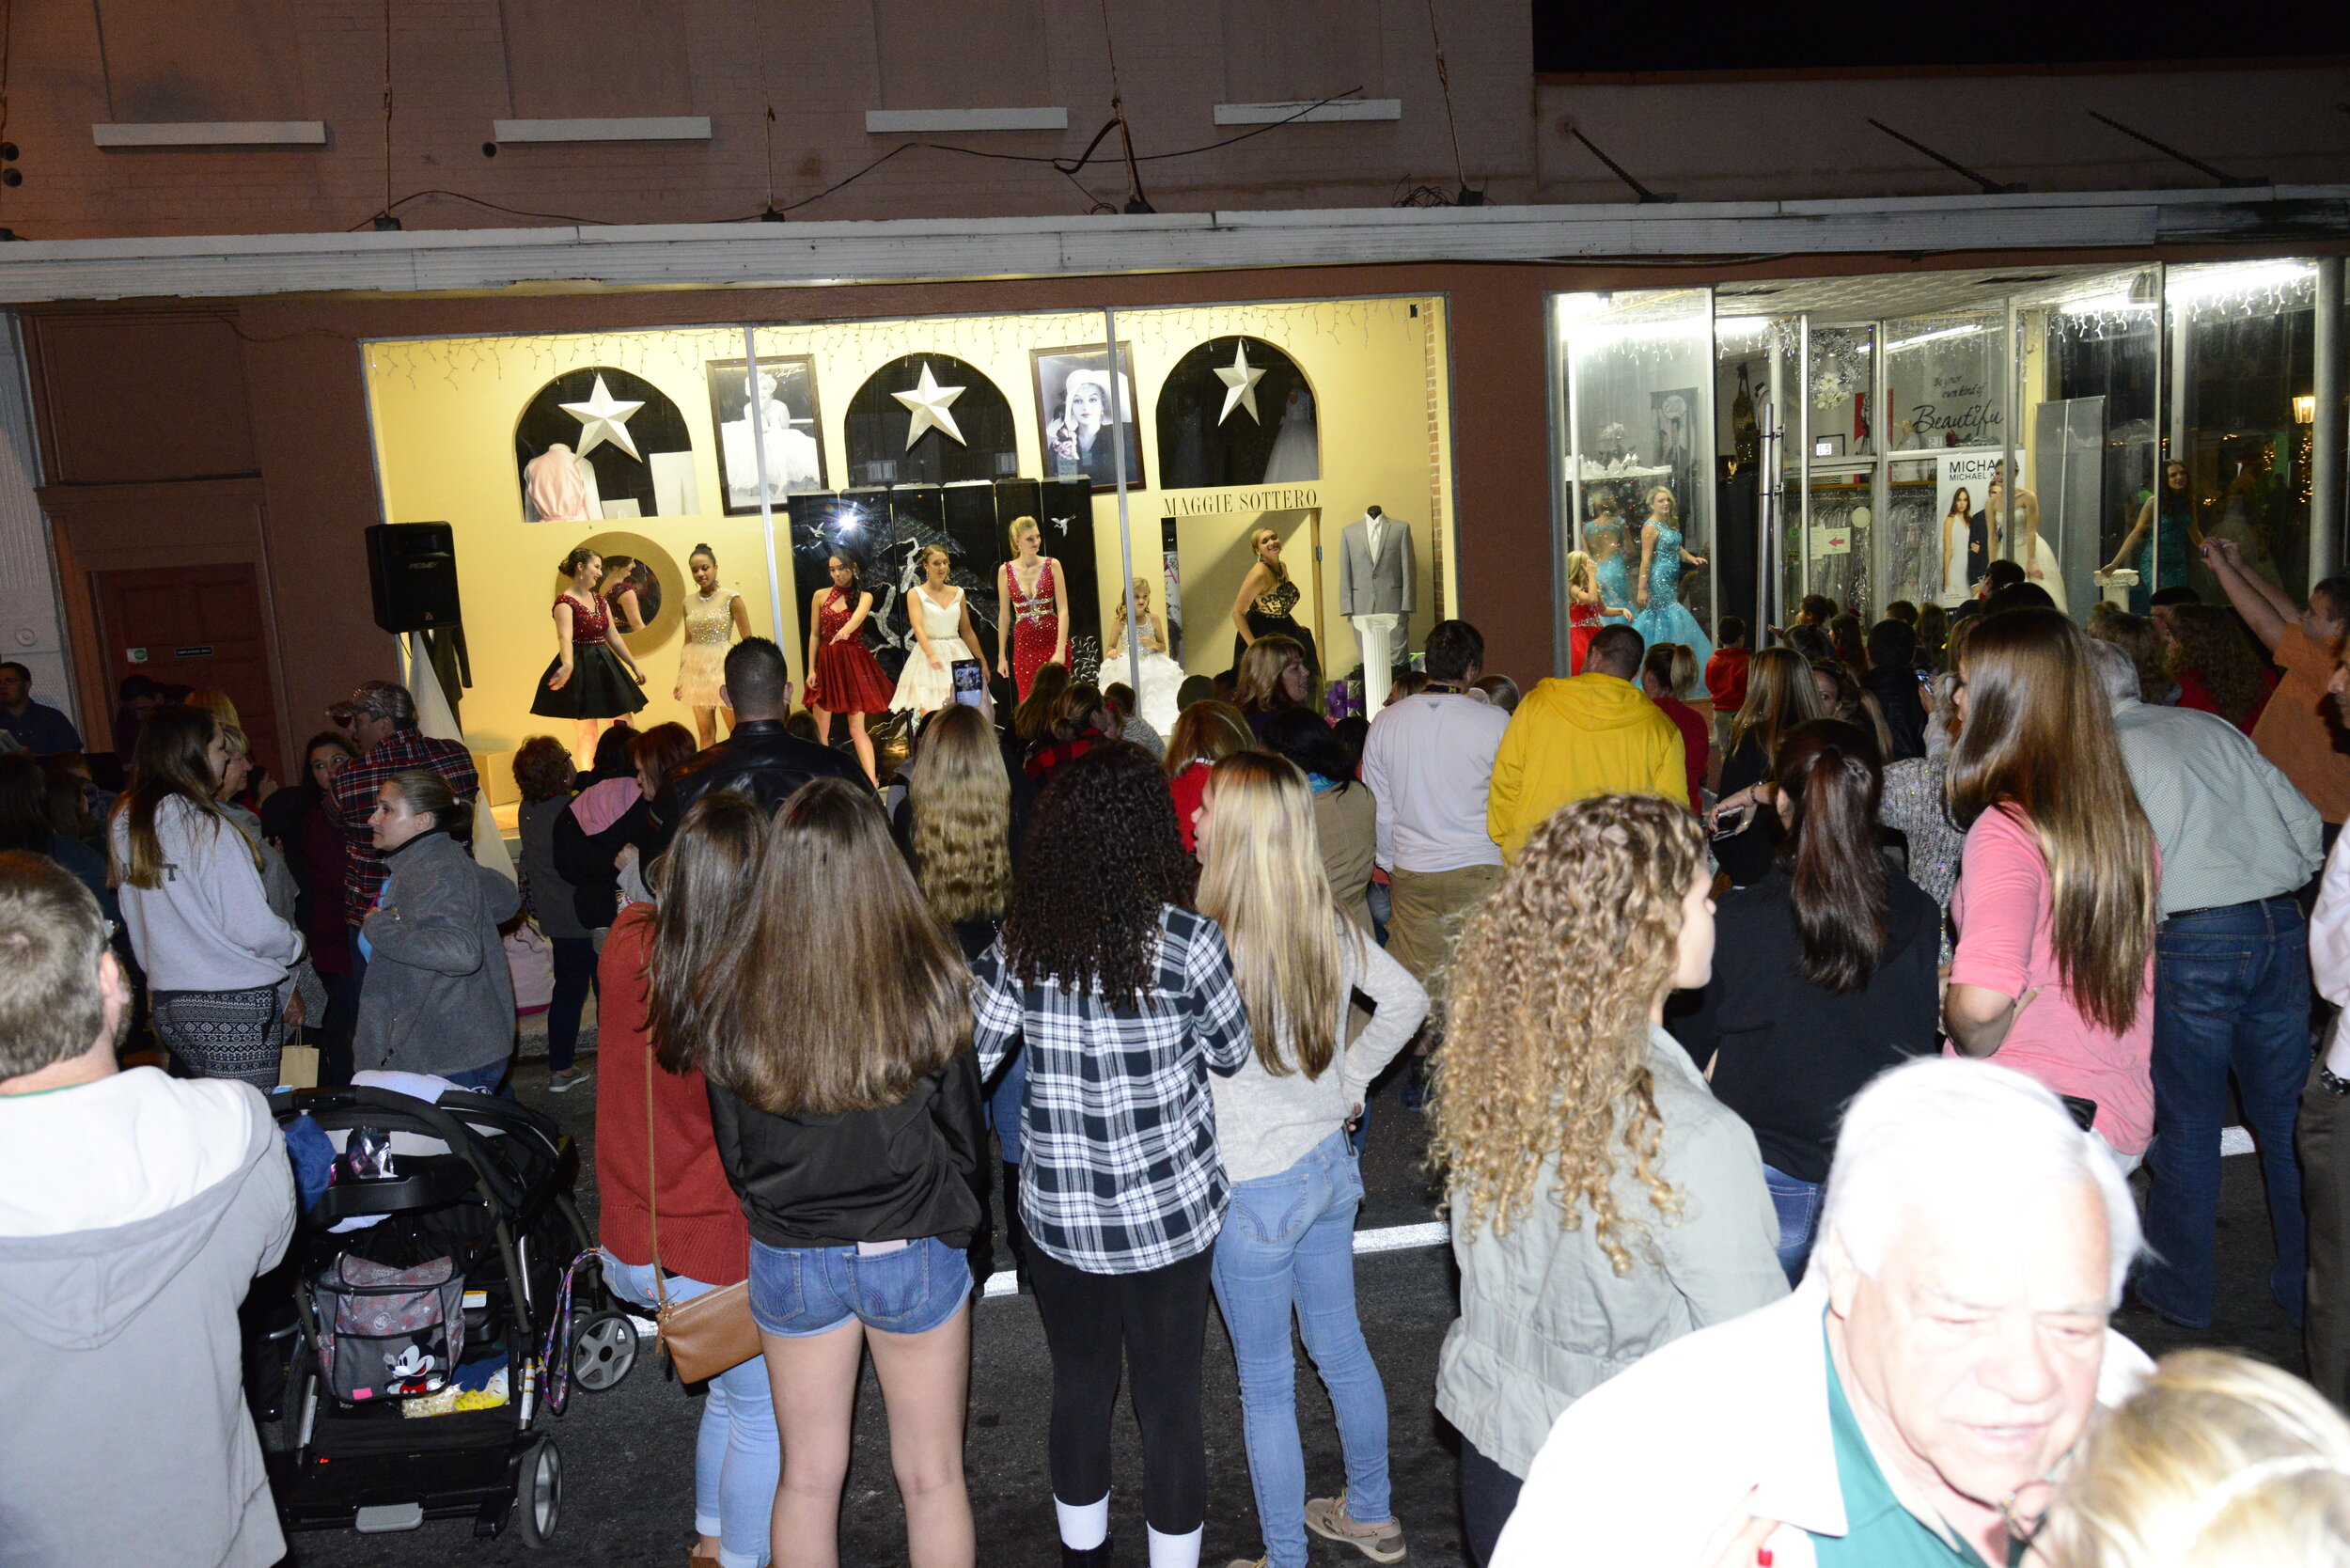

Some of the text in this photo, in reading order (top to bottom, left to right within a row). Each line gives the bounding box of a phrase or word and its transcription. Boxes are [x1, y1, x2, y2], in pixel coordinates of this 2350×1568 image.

[1912, 399, 2004, 436] Beautifu
[1949, 460, 1996, 473] MICHA
[1949, 472, 1987, 481] MICHAEL
[1164, 488, 1318, 516] MAGGIE SOTTERO
